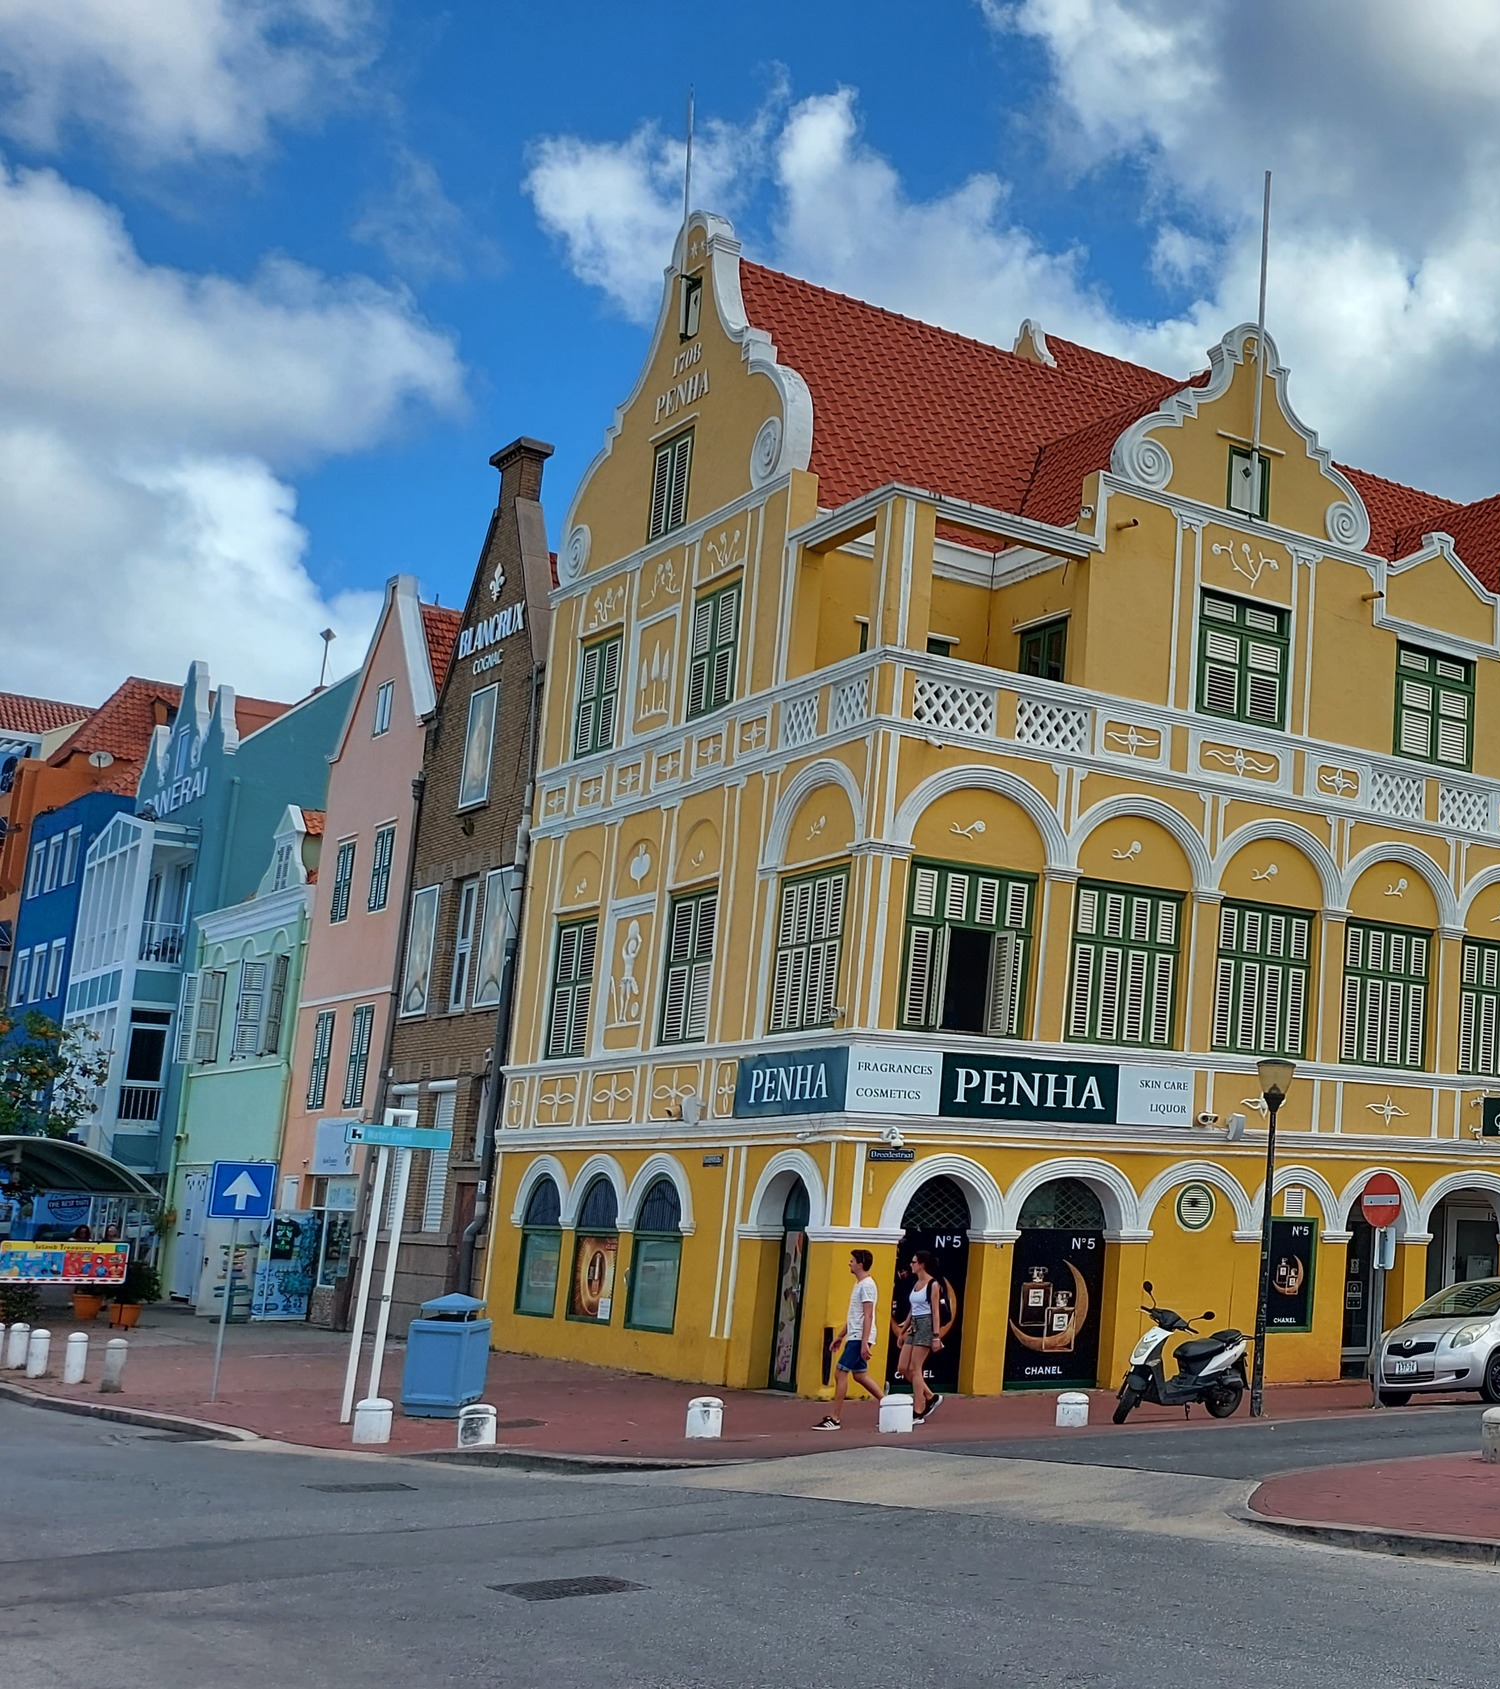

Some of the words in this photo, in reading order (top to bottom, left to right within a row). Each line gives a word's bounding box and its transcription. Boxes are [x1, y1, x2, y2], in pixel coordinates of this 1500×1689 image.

[673, 342, 703, 379] 1708
[654, 368, 710, 425] PENHA
[458, 600, 526, 660] BLANCRUX
[472, 648, 505, 676] COGNAC
[857, 1061, 934, 1076] FRAGRANCES
[748, 1062, 829, 1104] PENHA
[952, 1067, 1106, 1111] PENHA
[1139, 1079, 1162, 1090] SKIN
[1164, 1080, 1189, 1091] CARE
[855, 1087, 922, 1100] COSMETICS
[1149, 1103, 1187, 1115] LIQUOR
[1292, 1225, 1310, 1237] N°5
[935, 1235, 962, 1249] N°5
[1071, 1237, 1096, 1250] N°5
[1024, 1366, 1063, 1375] CHANEL
